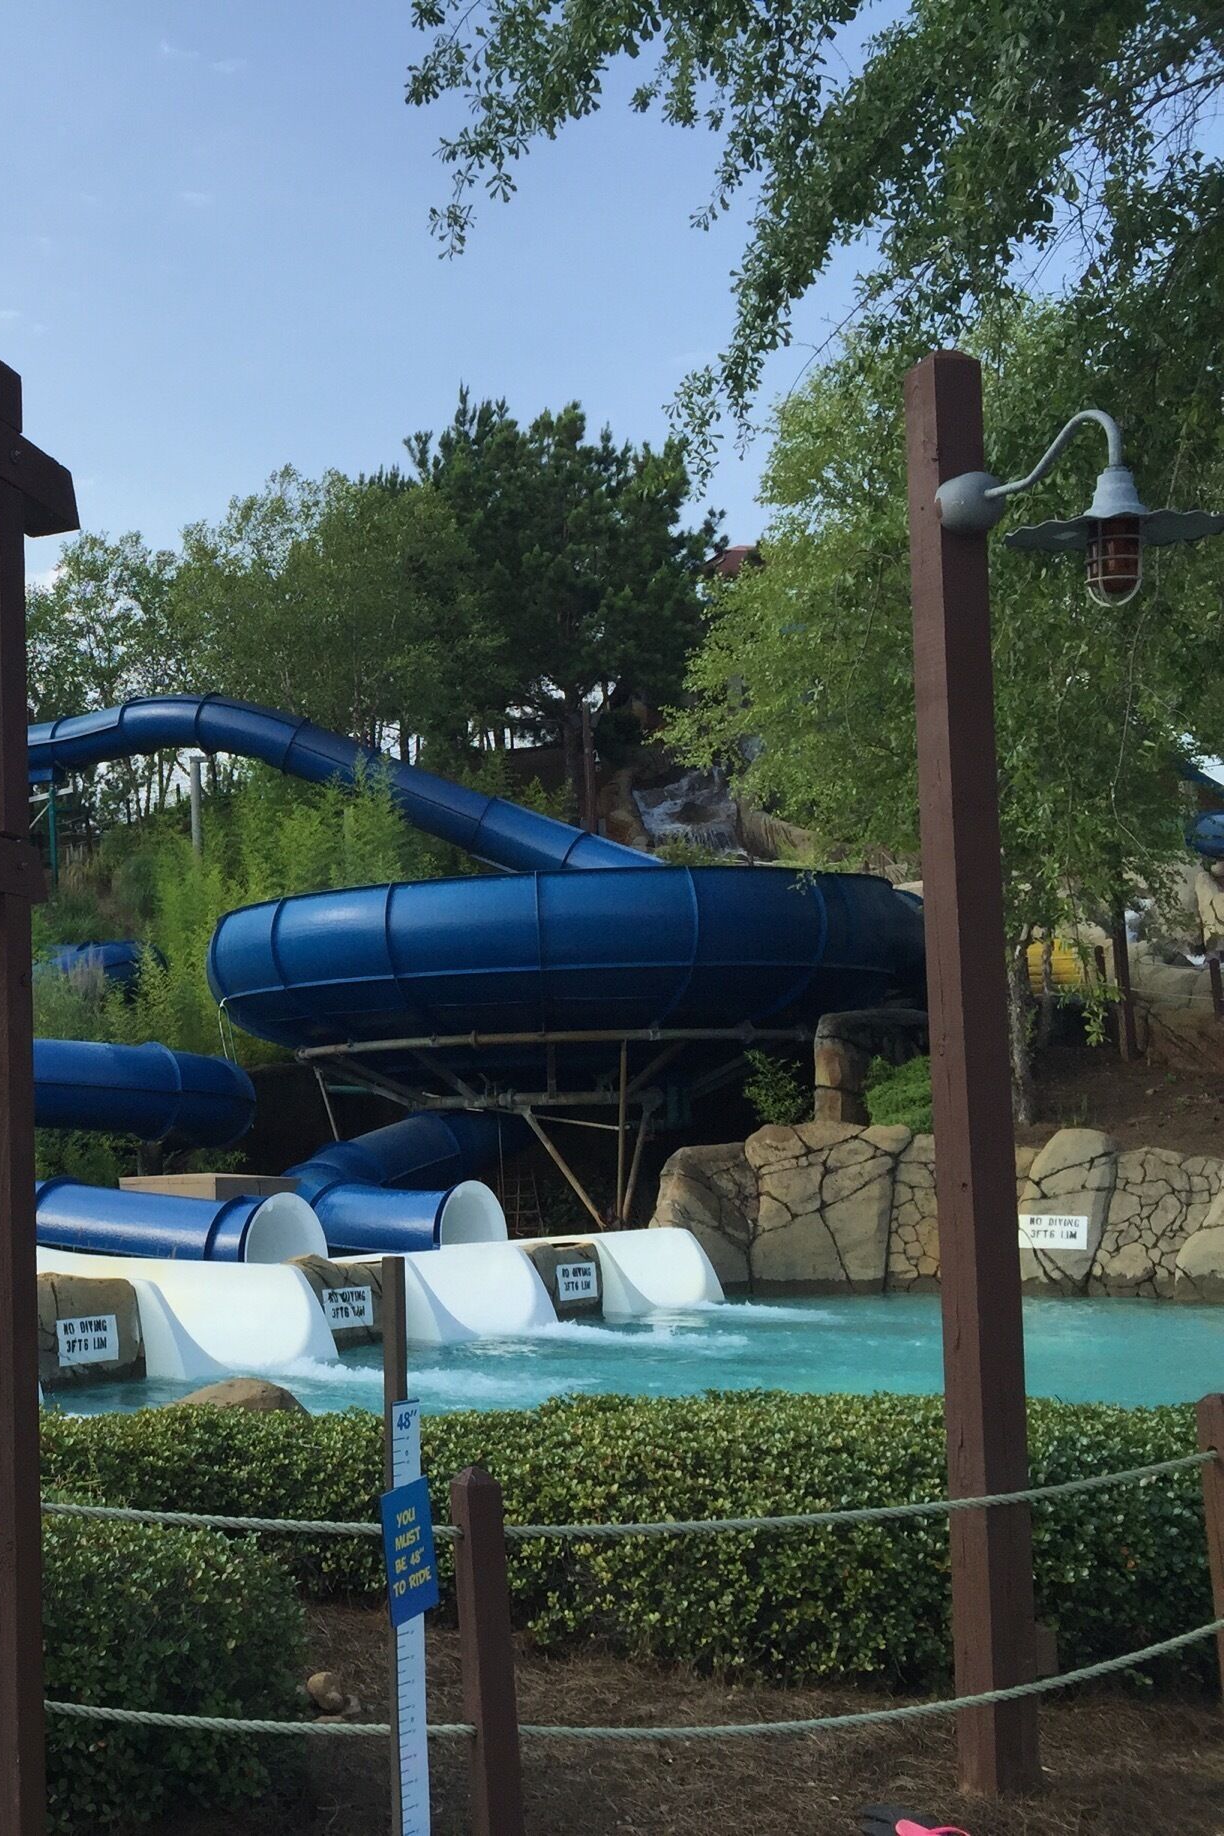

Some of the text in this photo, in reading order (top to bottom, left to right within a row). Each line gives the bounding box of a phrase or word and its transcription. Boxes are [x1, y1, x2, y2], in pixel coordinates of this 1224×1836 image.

[1029, 1217, 1080, 1228] NO DIVING
[63, 1319, 108, 1335] NO DIVING
[396, 1507, 416, 1528] YOU
[395, 1526, 421, 1551] MUST
[395, 1555, 407, 1575] BE
[393, 1565, 432, 1598] TO RIDE
